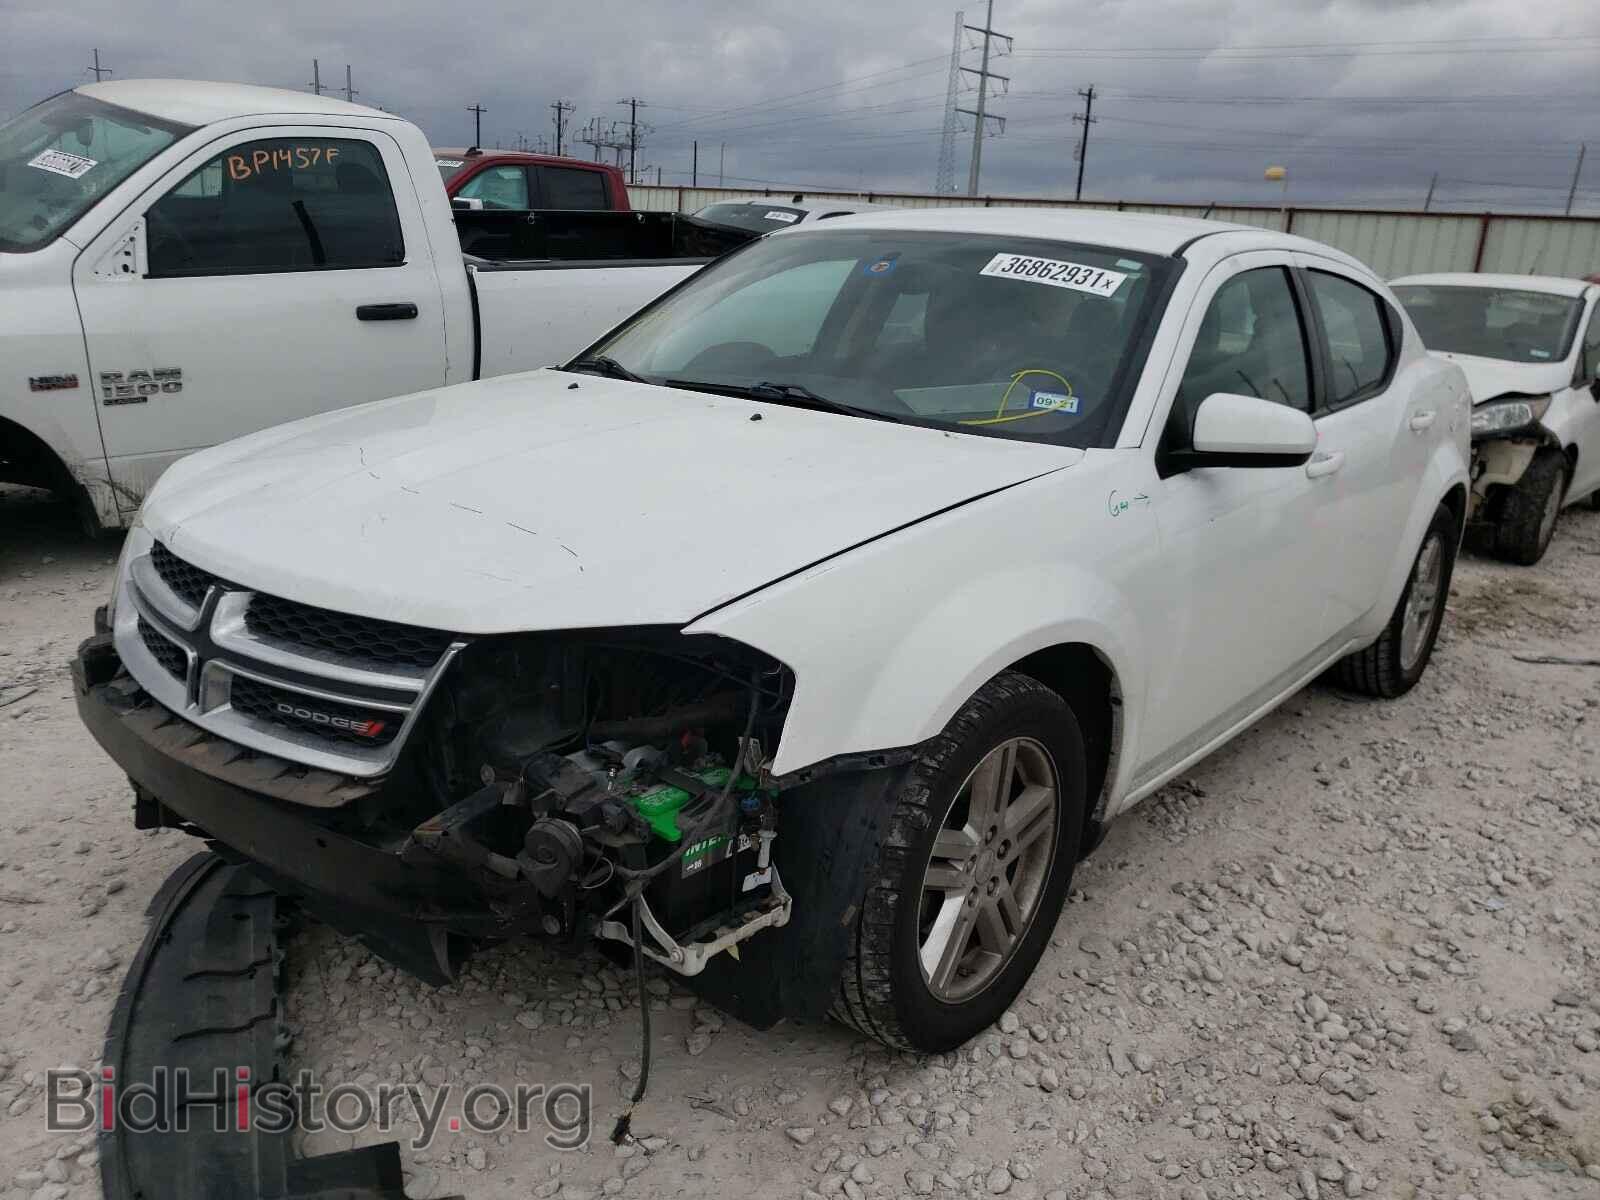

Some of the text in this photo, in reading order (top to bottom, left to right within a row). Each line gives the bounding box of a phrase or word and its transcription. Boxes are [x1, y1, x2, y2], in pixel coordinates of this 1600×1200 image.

[227, 145, 340, 180] BP1457F
[1001, 256, 1105, 288] 36862931
[101, 381, 183, 397] 1500
[277, 703, 369, 734] DODGE
